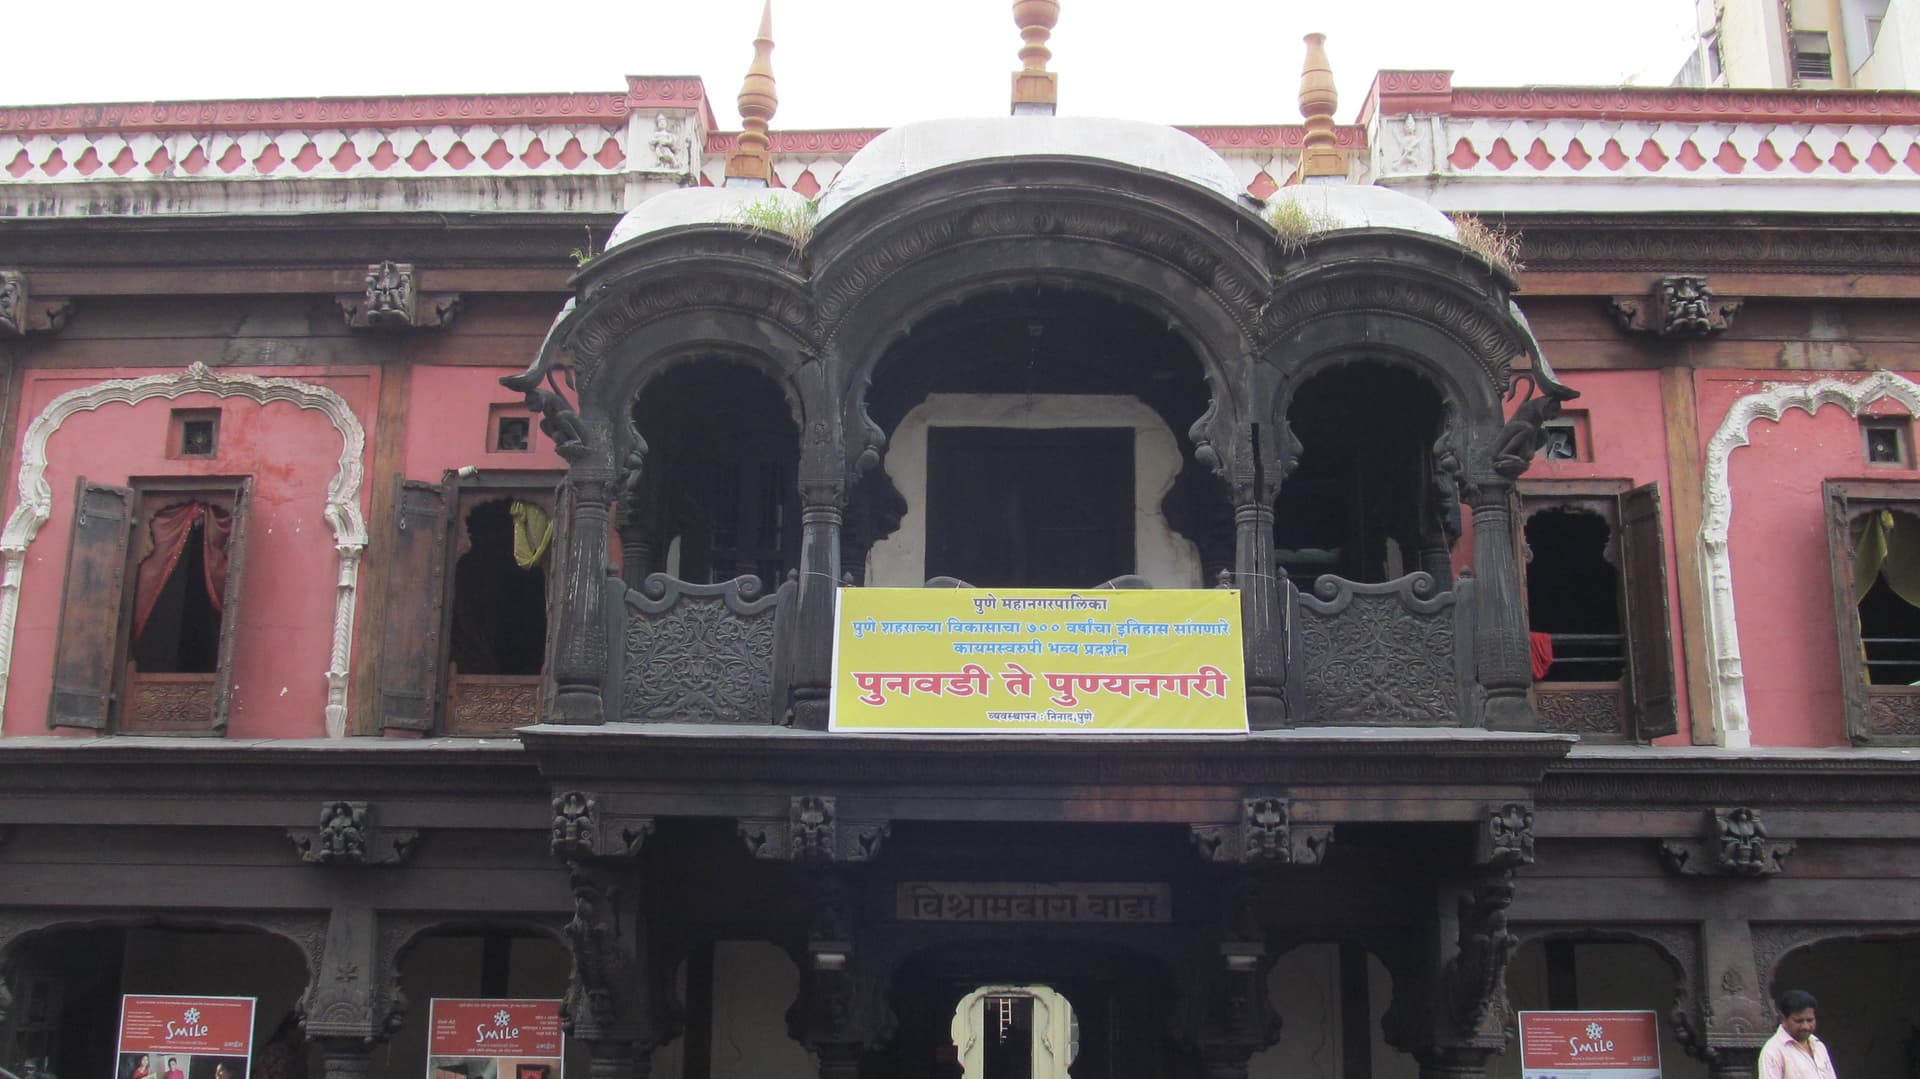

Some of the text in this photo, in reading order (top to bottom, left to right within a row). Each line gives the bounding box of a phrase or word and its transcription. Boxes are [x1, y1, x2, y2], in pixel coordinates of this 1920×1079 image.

[973, 594, 1107, 614] पुणे महानगरपालिका
[853, 617, 876, 637] पुणे
[881, 620, 942, 634] शहराच्या
[947, 618, 1020, 633] विकासाचा
[1026, 622, 1060, 634] ७००
[1116, 619, 1169, 636] इतिहास
[1174, 619, 1230, 635] सांगणारे
[1048, 642, 1078, 656] भव्य
[1085, 640, 1128, 656] प्रदर्शन
[851, 663, 1230, 707] पुनवडी ते पुण्यनगरी
[1087, 894, 1157, 919] वाडा
